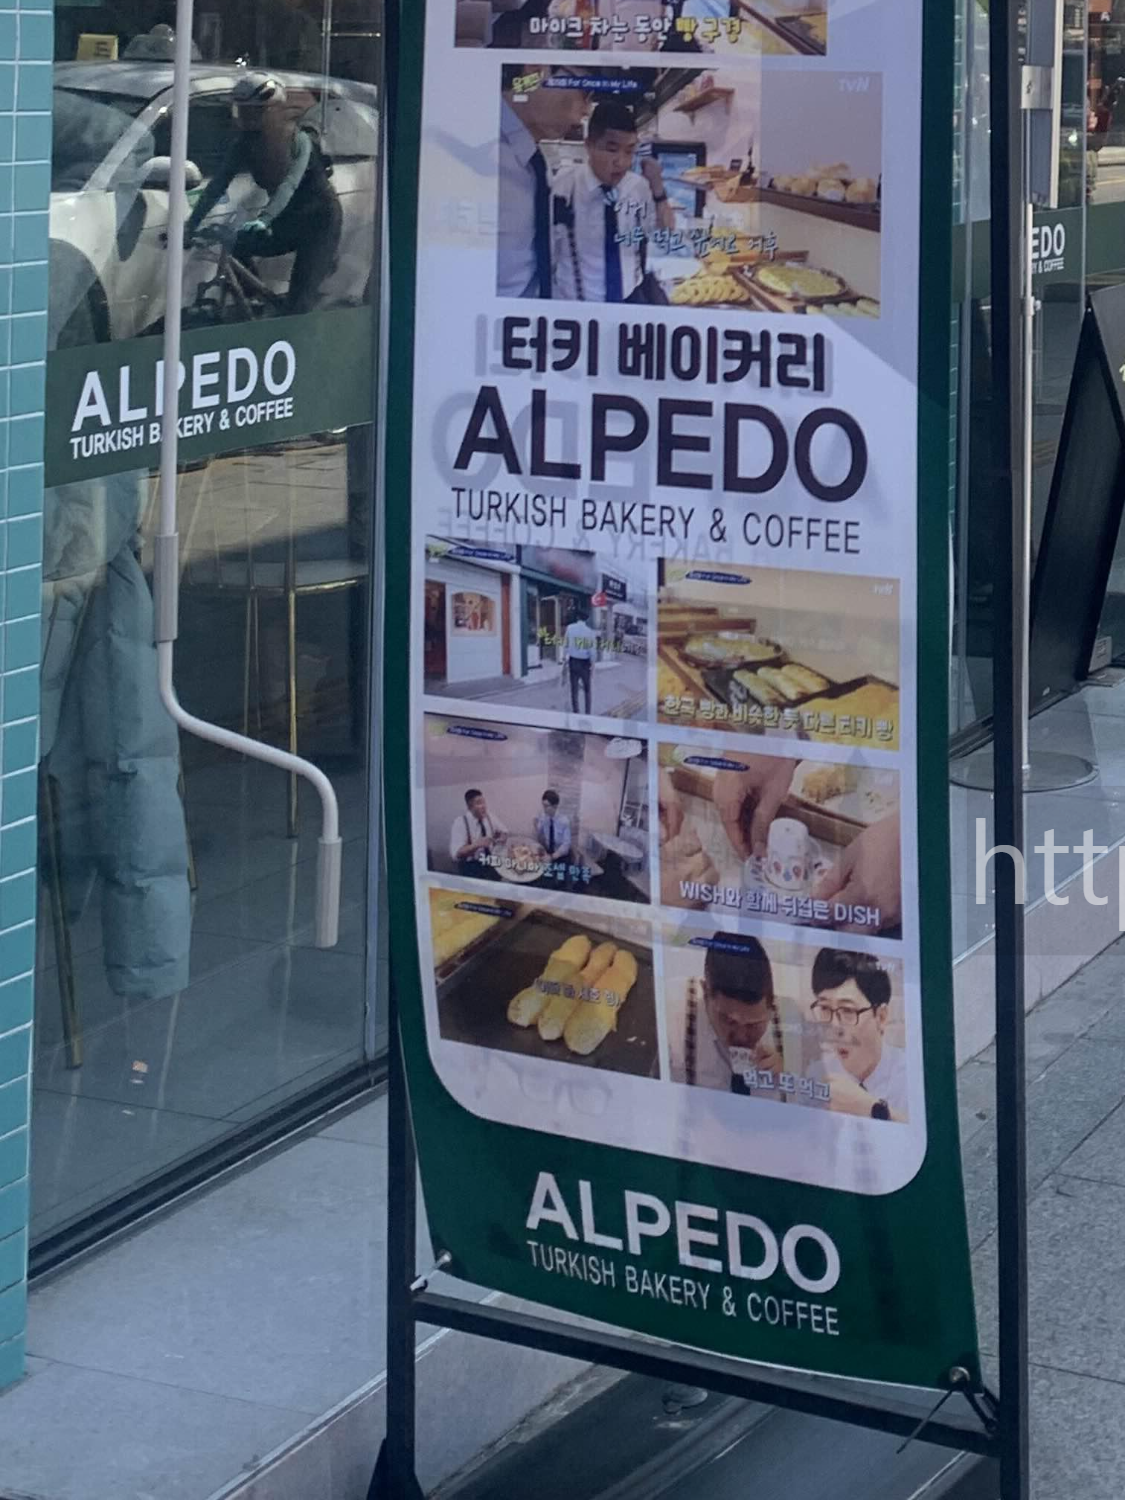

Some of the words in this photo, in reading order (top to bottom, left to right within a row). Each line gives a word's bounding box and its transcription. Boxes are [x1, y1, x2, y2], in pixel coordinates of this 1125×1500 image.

[529, 16, 584, 38] 마이크
[589, 15, 630, 43] 차는
[633, 15, 673, 46] 동안
[675, 16, 698, 42] 빵
[701, 17, 743, 43] 구경
[1031, 223, 1065, 260] EDO
[71, 340, 296, 432] ALPEDO
[502, 315, 599, 377] 터키
[618, 321, 826, 393] 베이커리
[70, 424, 144, 460] TURKISH
[149, 411, 215, 445] BKERY
[219, 408, 231, 430] &
[235, 397, 294, 427] COFFEE
[452, 384, 868, 503] ALPEDO
[451, 486, 567, 529] TURKISH
[581, 498, 694, 542] BAKERY
[709, 507, 728, 544] &
[742, 511, 861, 556] COFFEE
[664, 694, 696, 717] 한국
[732, 702, 780, 729] 비슷한
[803, 712, 836, 734] 다른
[837, 714, 873, 739] 터키
[876, 718, 894, 742] 빵
[679, 880, 742, 909] WISH와
[834, 902, 881, 927] DISH
[743, 1069, 775, 1089] 먹고
[799, 1078, 830, 1101] 먹고
[525, 1170, 841, 1294] ALPEDO
[526, 1240, 616, 1288] TURKISH
[625, 1265, 711, 1311] BAKERY
[722, 1285, 737, 1318] &
[747, 1292, 840, 1336] COFFEE
